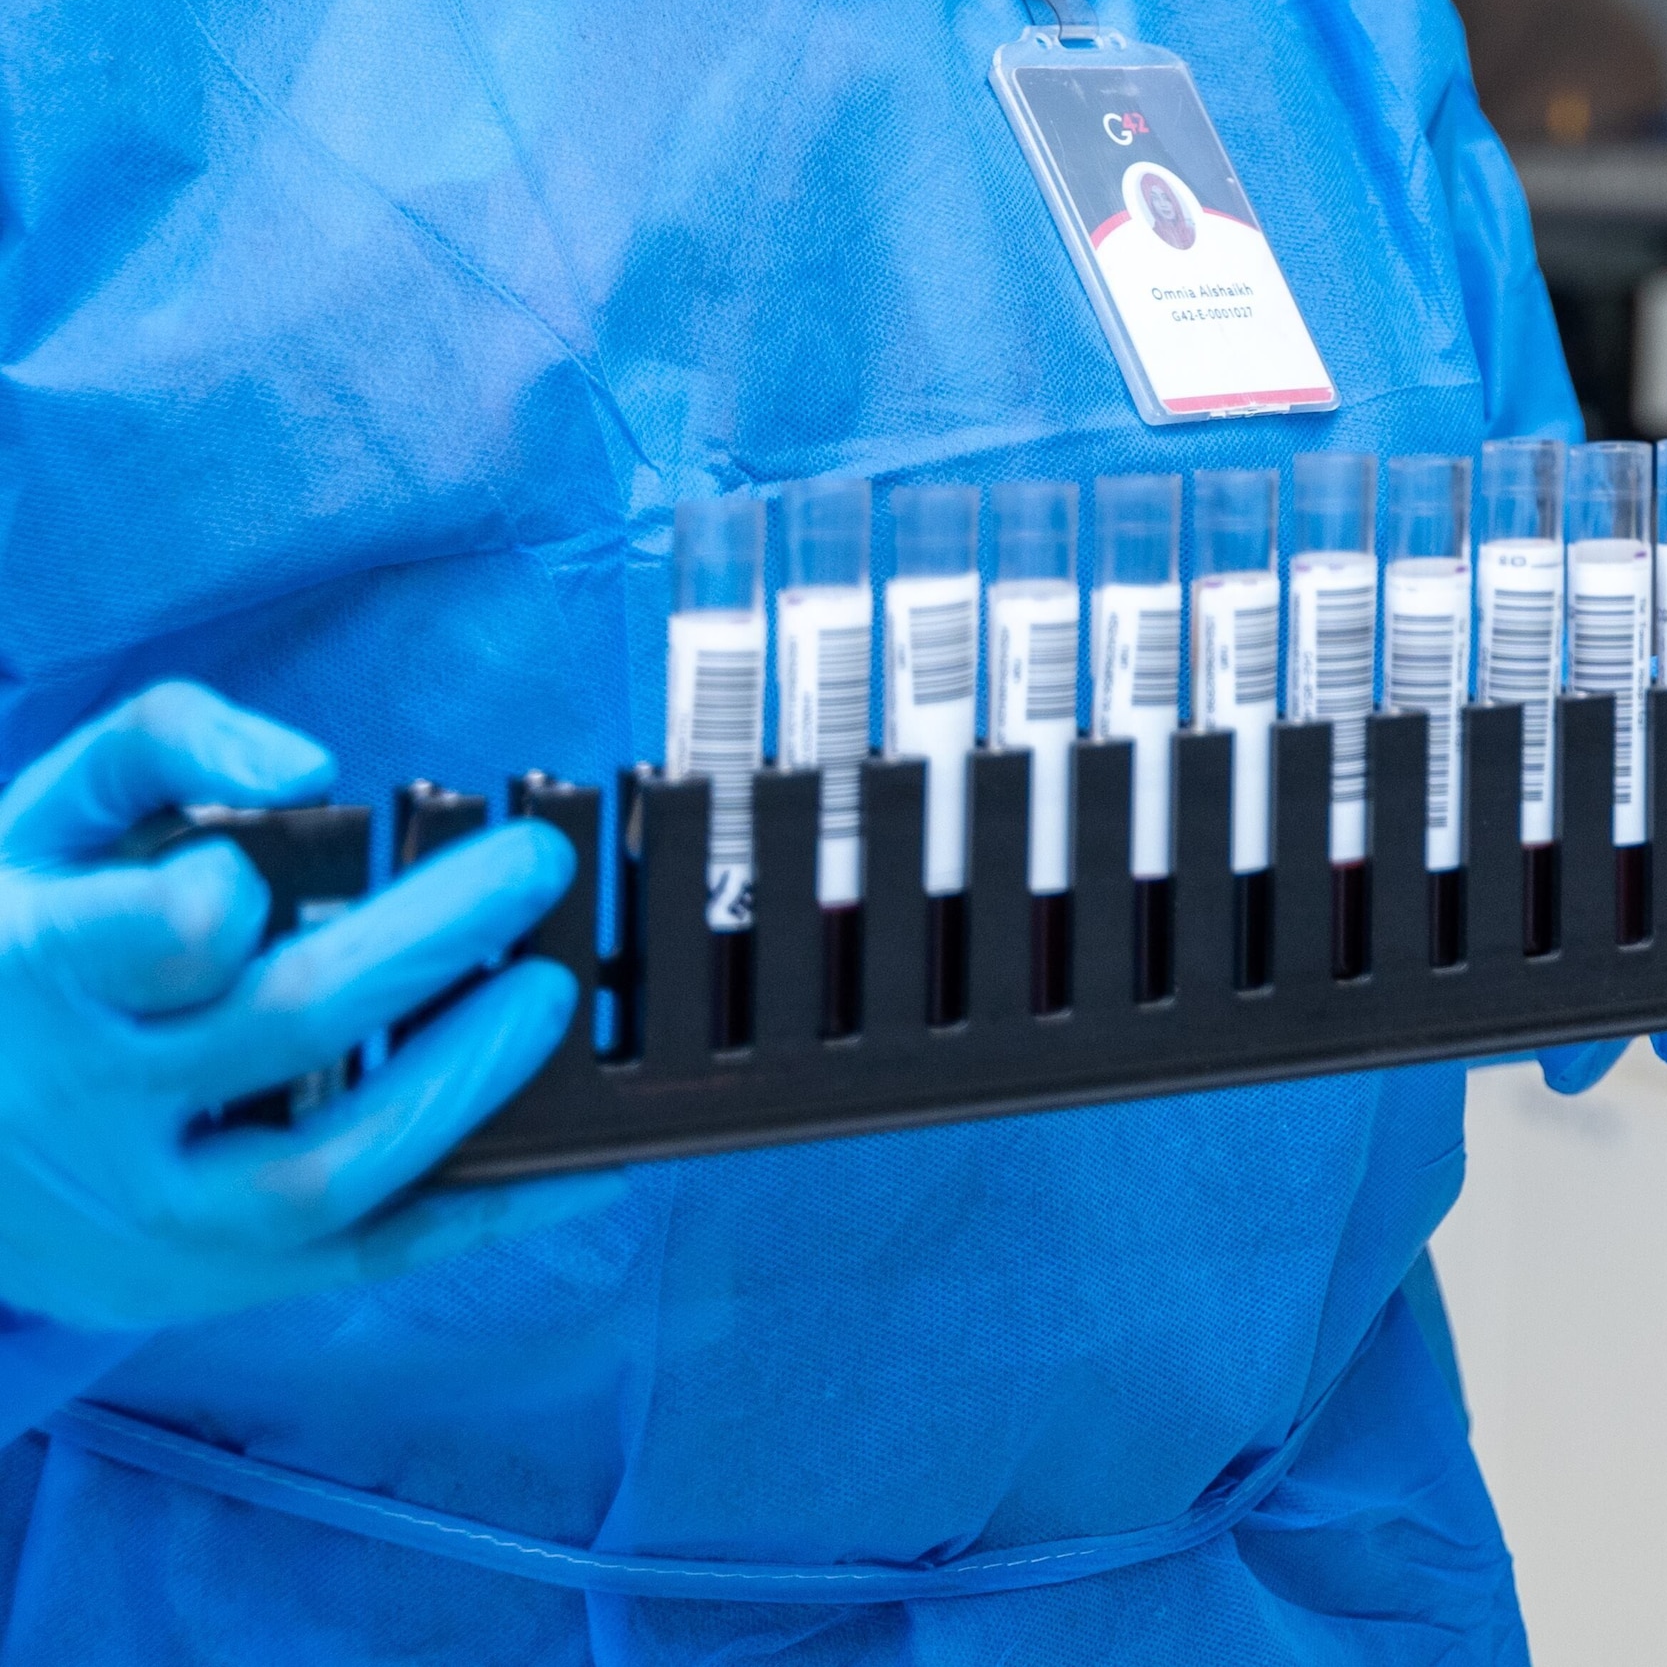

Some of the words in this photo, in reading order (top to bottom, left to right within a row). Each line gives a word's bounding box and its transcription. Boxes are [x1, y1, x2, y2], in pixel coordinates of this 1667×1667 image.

[1103, 112, 1150, 146] G42
[1151, 285, 1197, 301] Omnia
[1199, 282, 1254, 298] Alshaikh
[1171, 306, 1253, 322] G42-E-0001027
